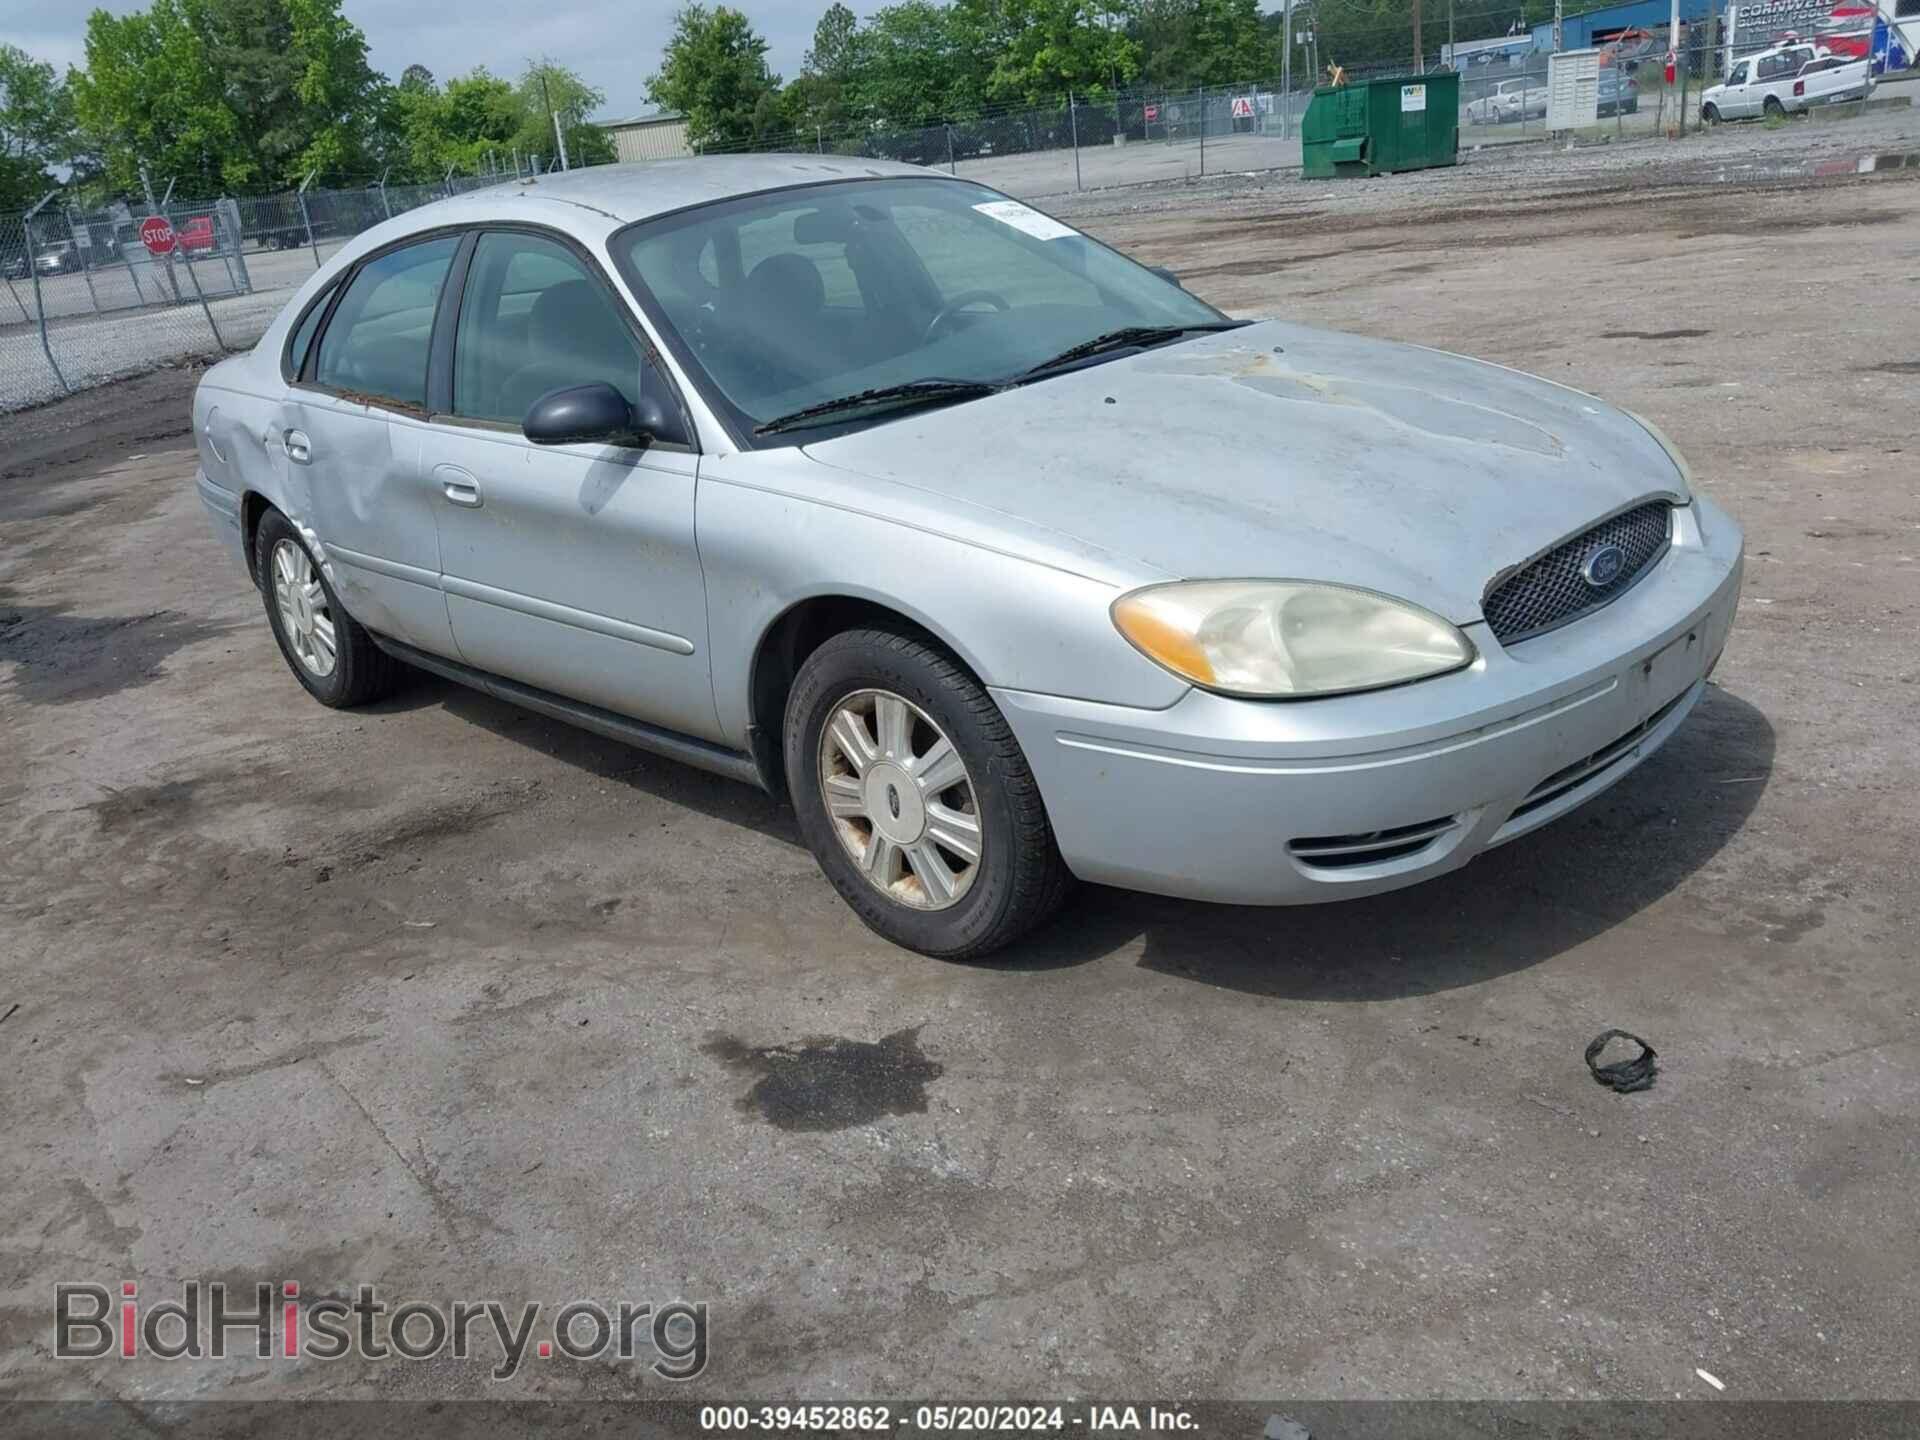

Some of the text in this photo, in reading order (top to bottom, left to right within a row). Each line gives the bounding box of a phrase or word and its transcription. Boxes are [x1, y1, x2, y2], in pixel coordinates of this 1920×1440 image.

[1737, 6, 1833, 28] QUALITY TOOLS
[143, 227, 174, 244] STOP
